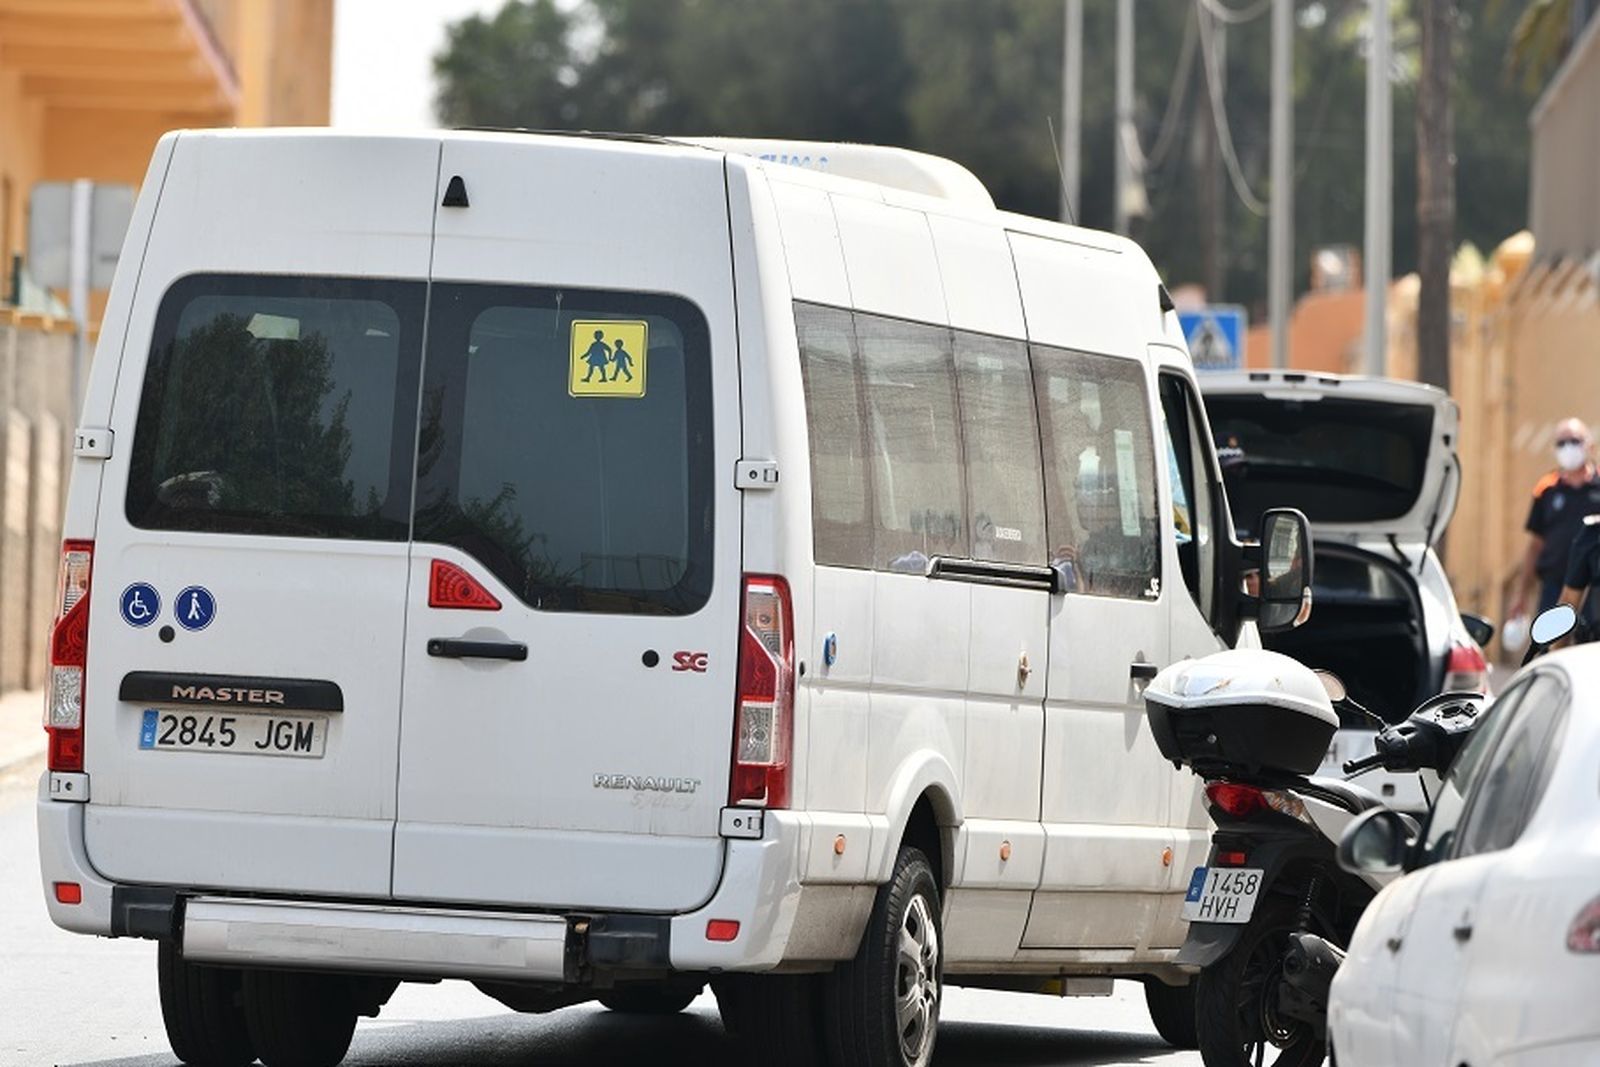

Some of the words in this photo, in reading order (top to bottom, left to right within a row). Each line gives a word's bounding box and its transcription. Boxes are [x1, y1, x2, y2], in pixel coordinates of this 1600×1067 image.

[172, 685, 284, 704] MASTER
[158, 715, 237, 747] 2845
[255, 719, 314, 752] JGM
[593, 772, 701, 793] RENAULT
[1210, 872, 1258, 895] 1458
[1199, 896, 1240, 918] HVH
